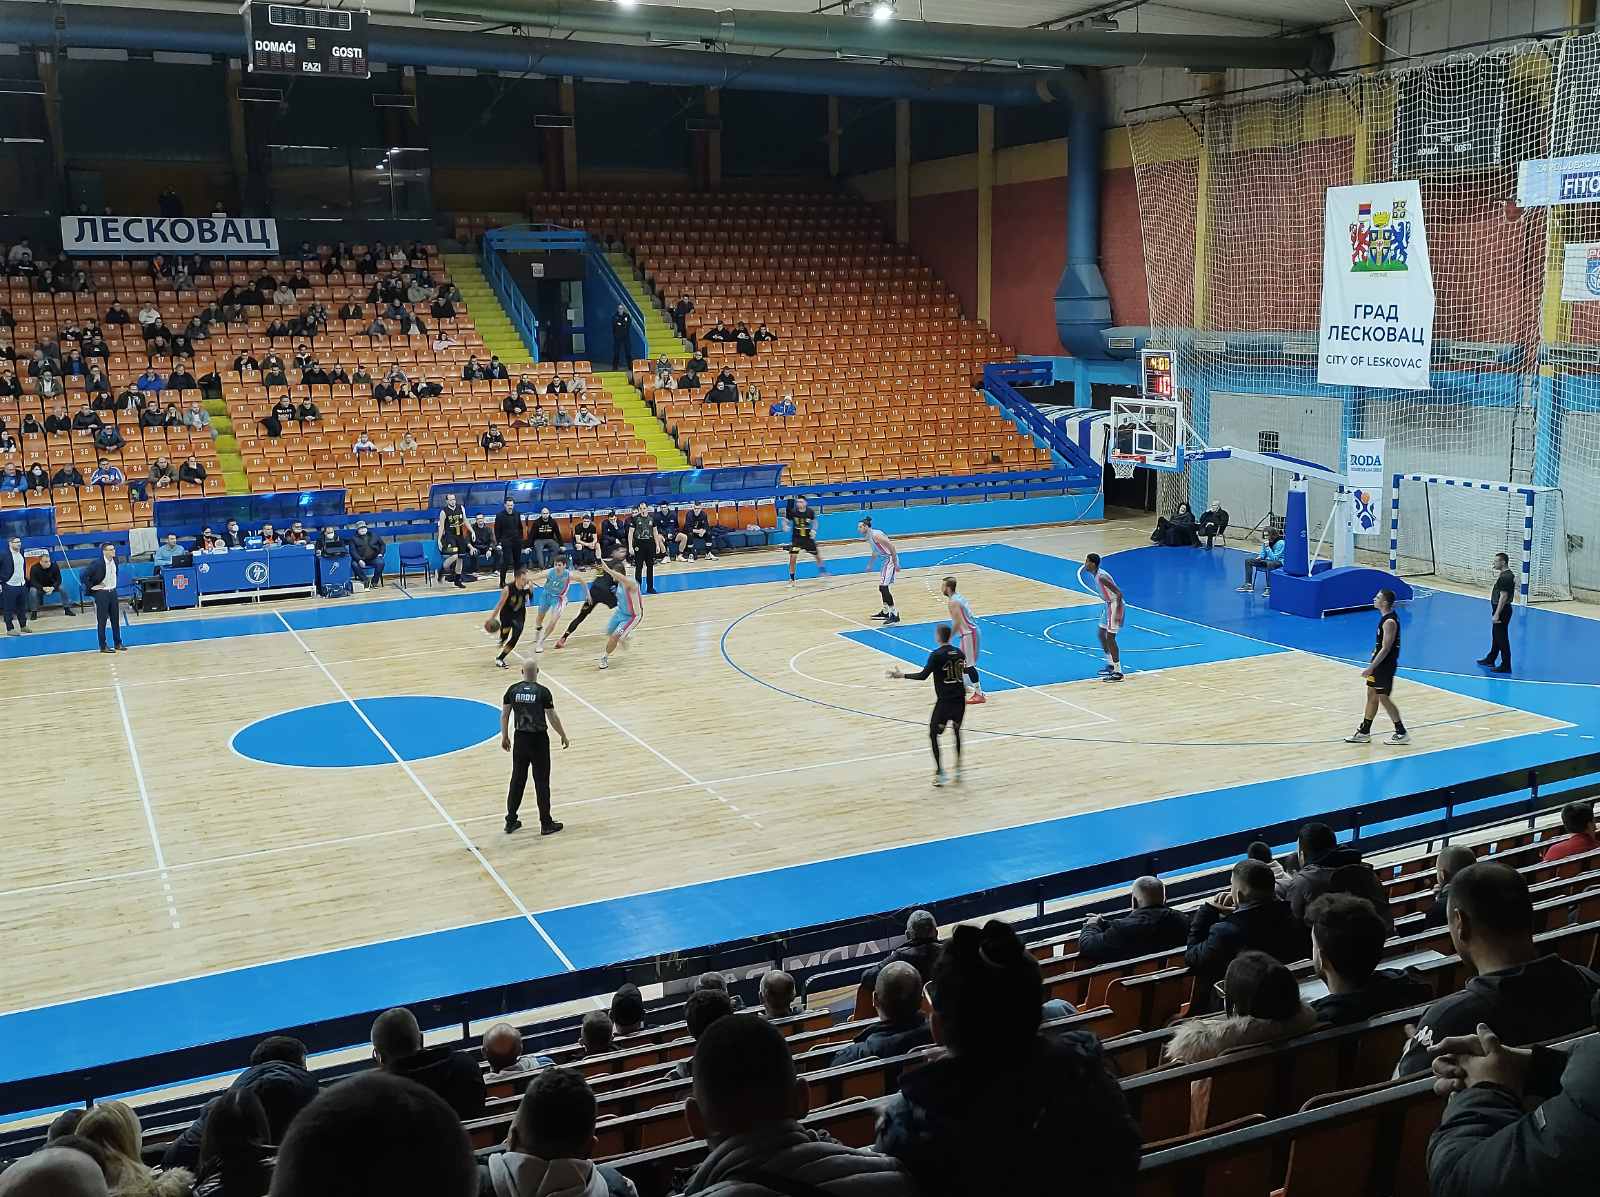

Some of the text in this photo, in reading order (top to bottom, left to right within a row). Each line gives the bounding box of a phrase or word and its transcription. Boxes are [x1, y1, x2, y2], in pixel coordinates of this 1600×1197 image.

[255, 40, 296, 54] DOMAĆI
[332, 46, 362, 58] GOSTI
[302, 62, 321, 72] FAZI
[74, 218, 270, 248] ЛЕСКОВАЦ
[1354, 304, 1398, 322] ГРАД
[1328, 325, 1424, 346] ЛЕСКОВАЦ
[1326, 355, 1422, 368] CITY OF LESKOVAC
[1350, 454, 1382, 466] RODA
